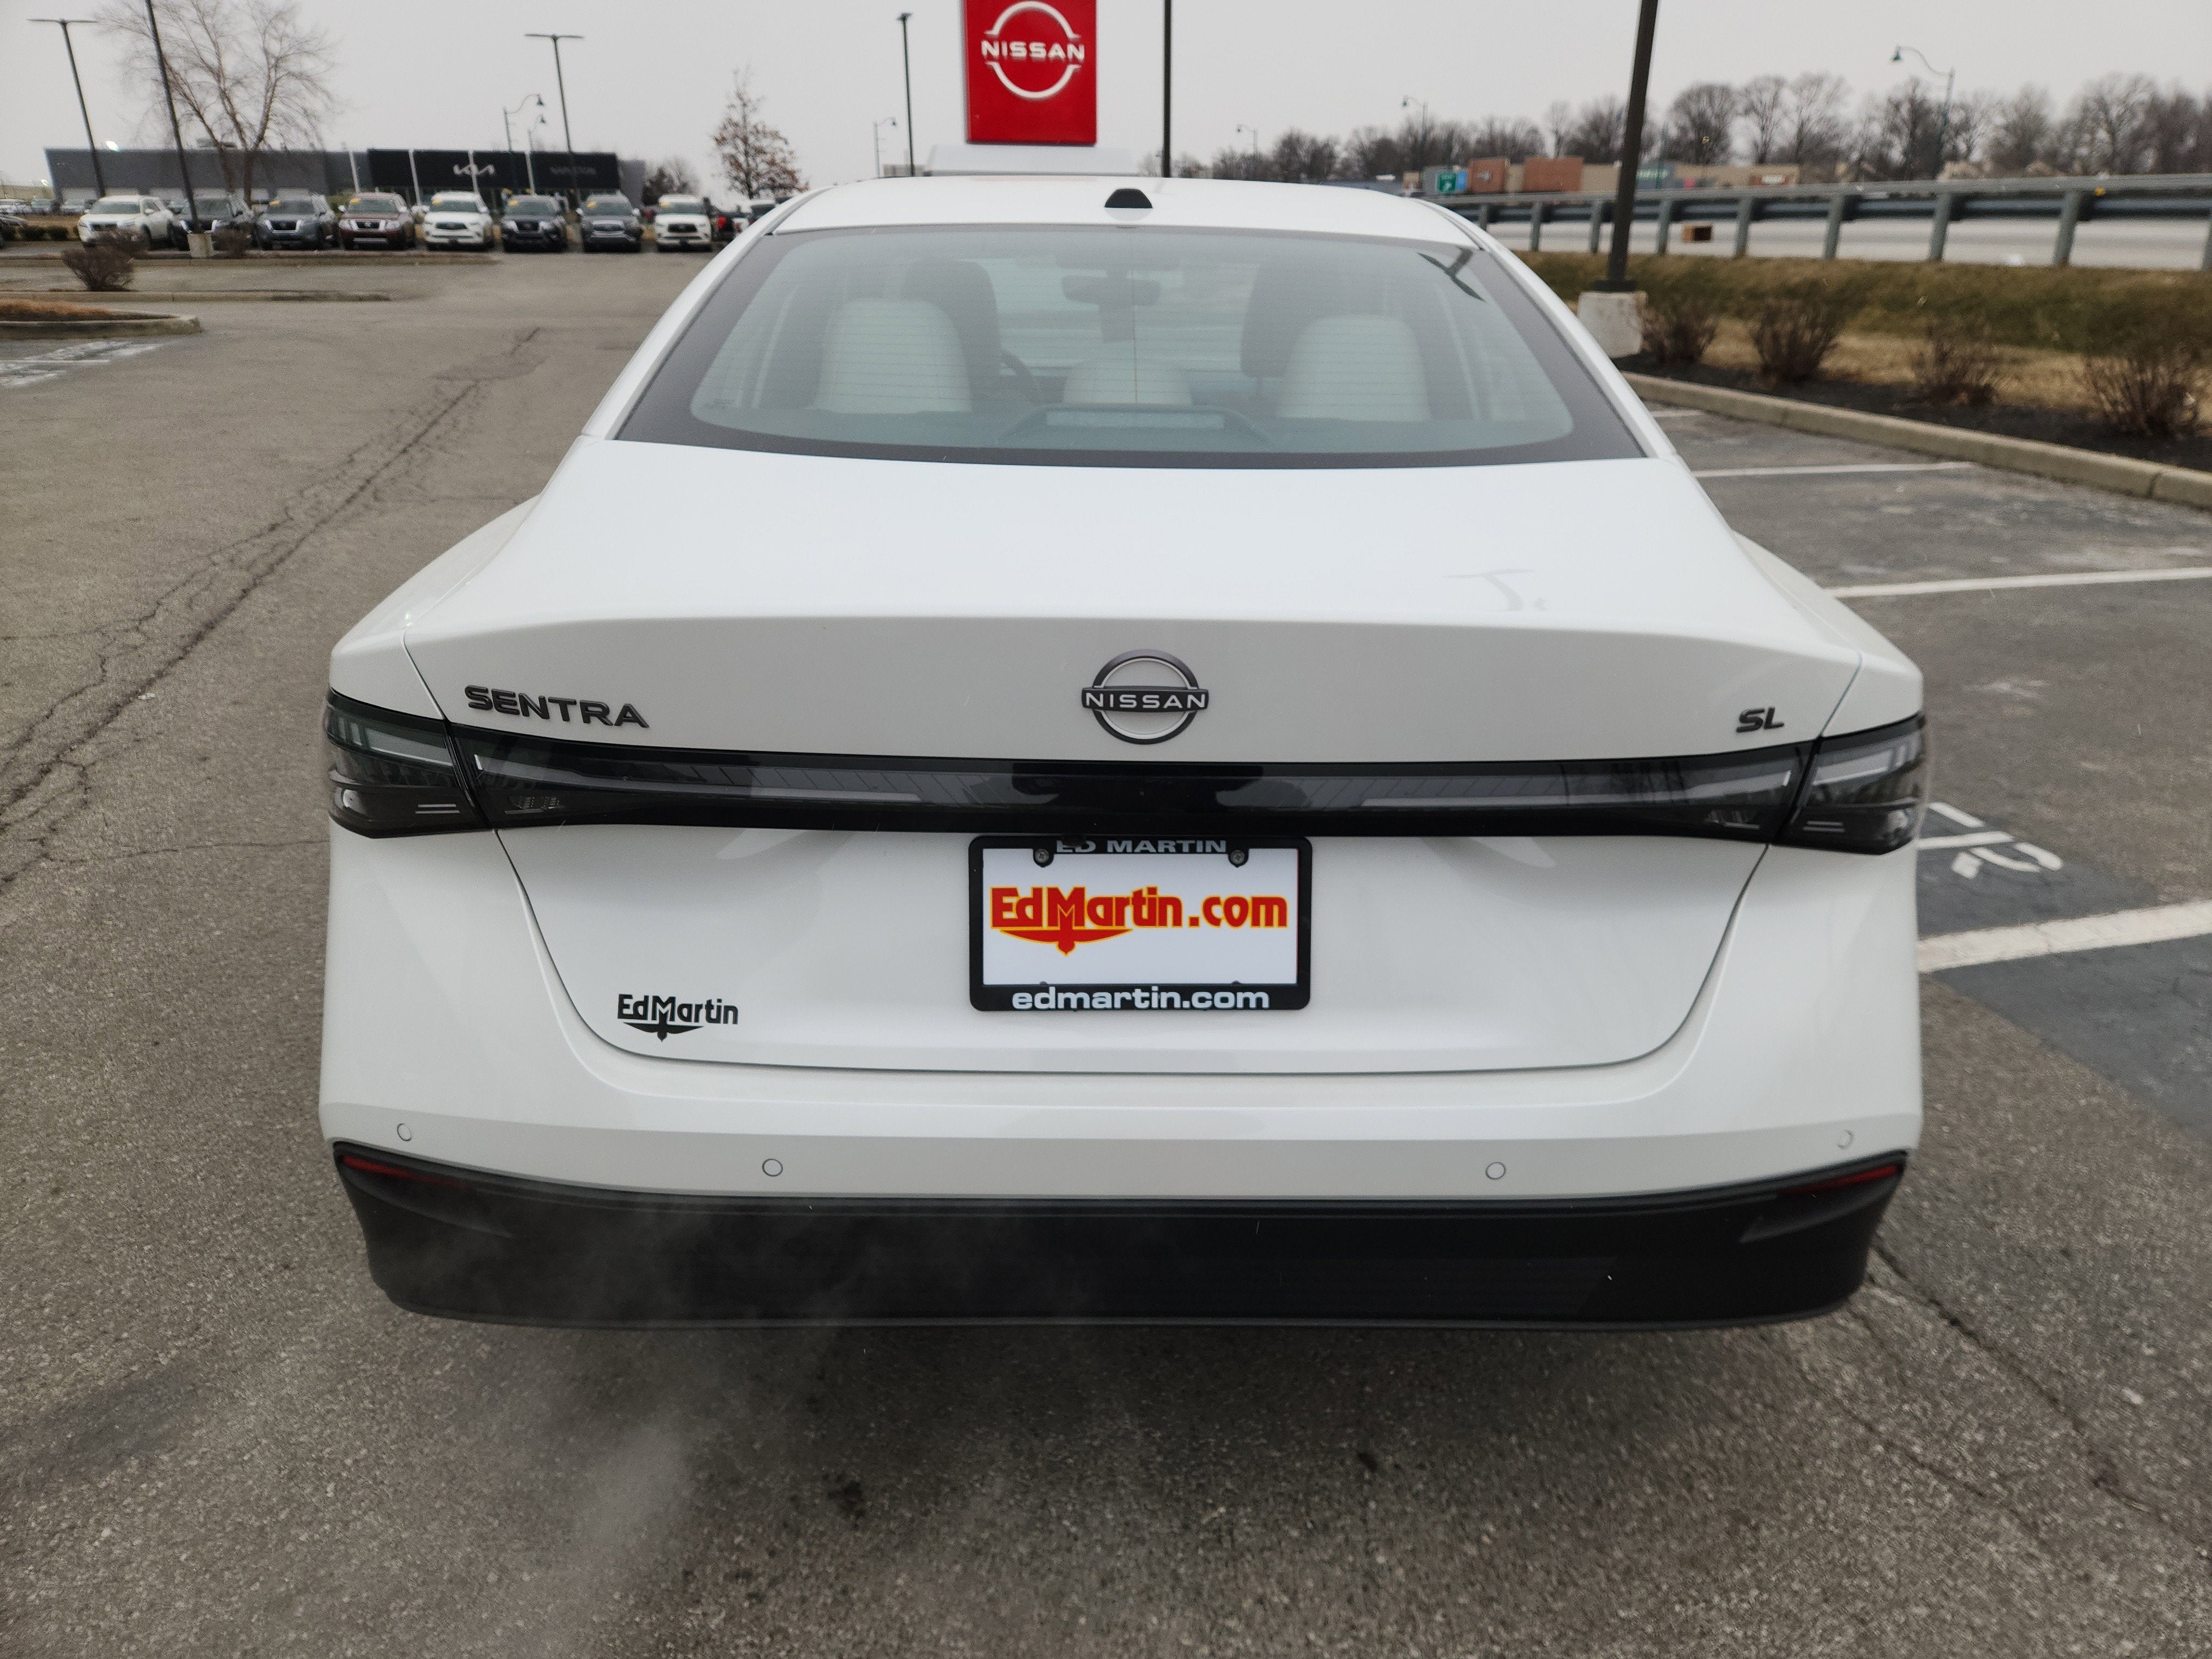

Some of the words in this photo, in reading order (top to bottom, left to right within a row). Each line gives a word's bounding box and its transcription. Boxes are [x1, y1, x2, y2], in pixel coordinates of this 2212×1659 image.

[981, 40, 1085, 62] NISSAN
[465, 685, 650, 728] SENTRA
[1086, 692, 1205, 709] NISSAN
[1736, 707, 1785, 732] SL
[1107, 840, 1226, 853] MARTIN
[990, 885, 1288, 929] EdMartin.com
[617, 993, 738, 1025] EdMartin
[1012, 986, 1270, 1009] edmartin.com
